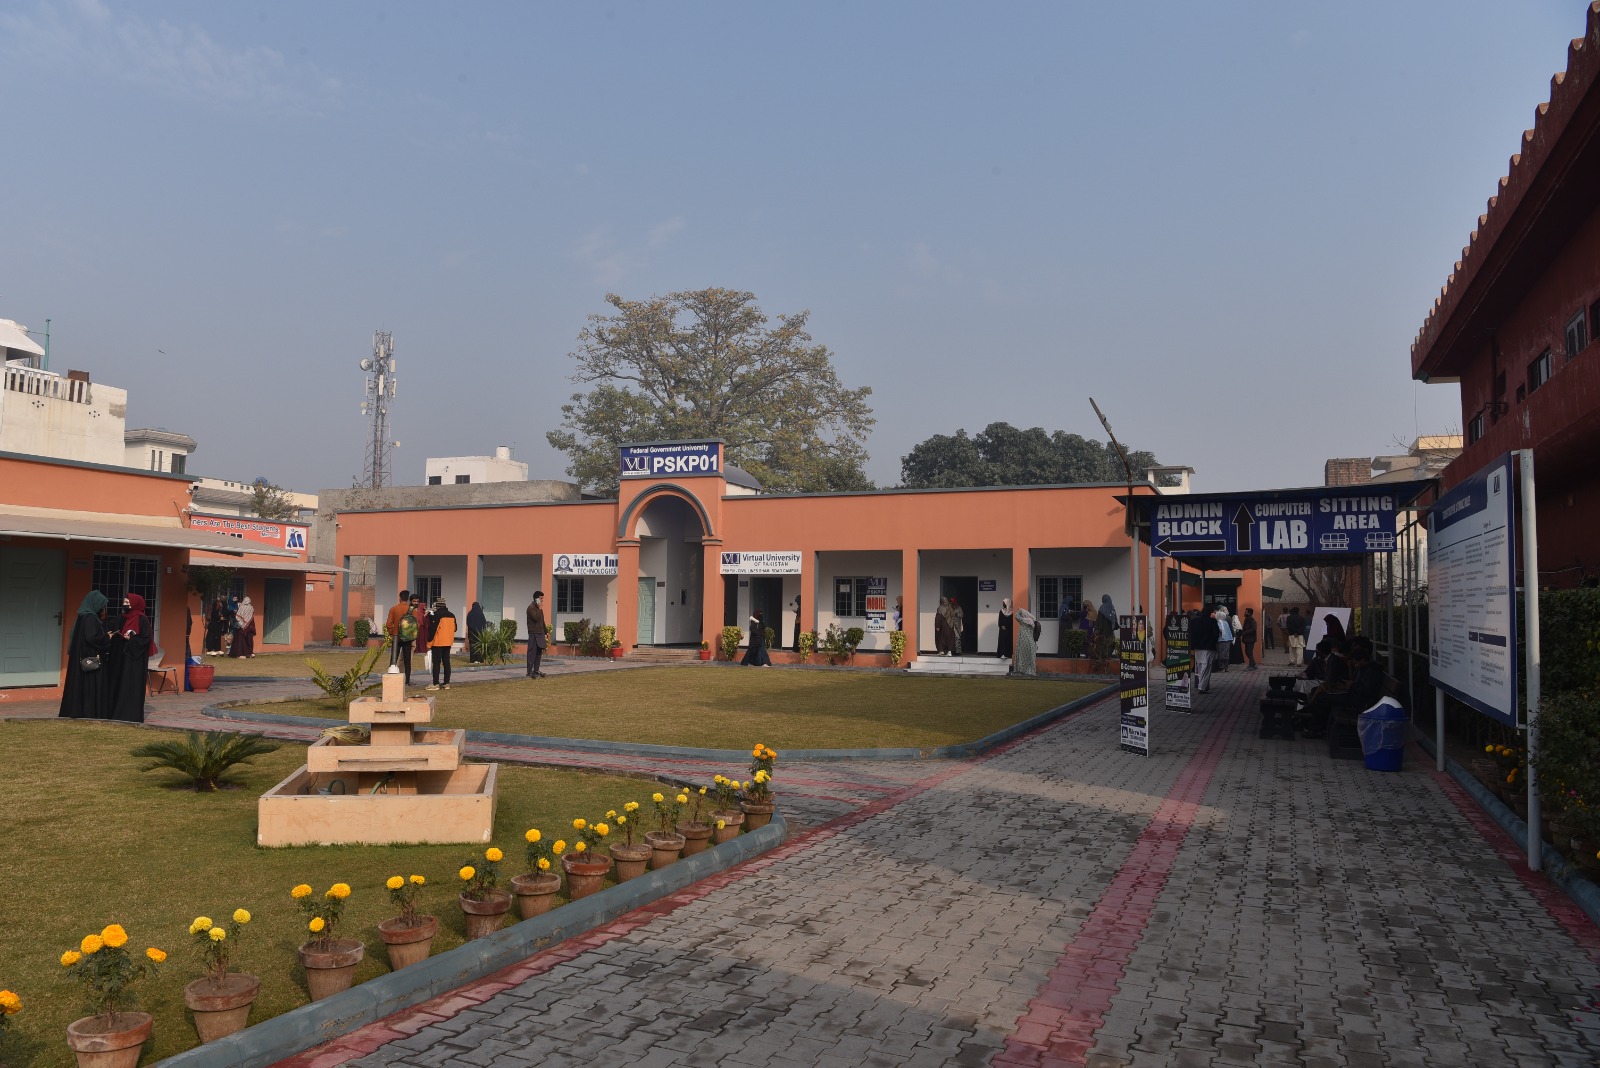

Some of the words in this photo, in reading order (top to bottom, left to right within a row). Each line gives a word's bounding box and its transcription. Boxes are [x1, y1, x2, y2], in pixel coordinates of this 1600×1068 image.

[654, 455, 718, 473] PSKP01
[1157, 503, 1223, 519] ADMIN
[1255, 502, 1312, 517] COMPUTER
[1320, 496, 1393, 513] SITTING
[209, 519, 221, 527] Are
[222, 520, 235, 529] The
[236, 521, 251, 530] Best
[252, 524, 280, 533] Students
[1158, 521, 1222, 536] BLOCK
[1334, 514, 1381, 530] AREA
[1260, 520, 1309, 550] LAB
[573, 556, 602, 567] Micro
[743, 554, 765, 562] Virtual
[767, 554, 800, 564] University
[867, 597, 886, 610] MOBILE
[1120, 663, 1146, 672] E-Commerce
[1120, 672, 1135, 680] Python
[1133, 695, 1147, 707] OPEN
